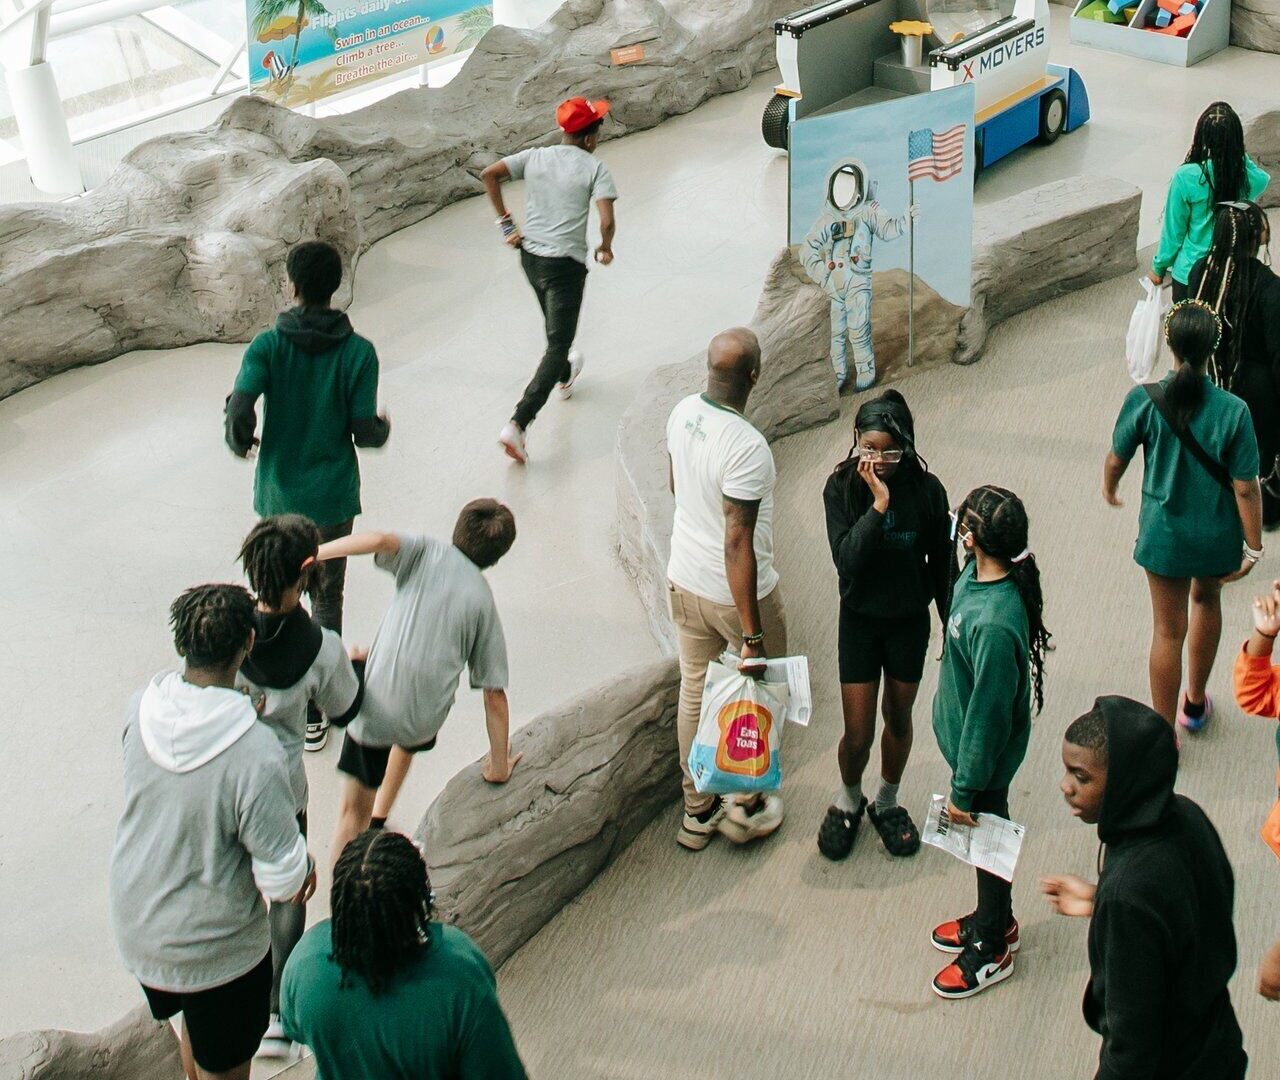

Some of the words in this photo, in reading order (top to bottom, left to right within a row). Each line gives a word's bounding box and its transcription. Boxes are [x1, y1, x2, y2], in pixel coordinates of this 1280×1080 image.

[311, 7, 357, 30] Flights
[335, 32, 363, 50] Swim
[365, 28, 376, 40] in
[378, 24, 390, 36] an
[336, 50, 365, 66] Climb
[367, 47, 373, 57] a
[963, 60, 974, 83] X
[980, 27, 1045, 74] MOVERS
[335, 64, 375, 85] Breathe
[377, 58, 393, 71] the
